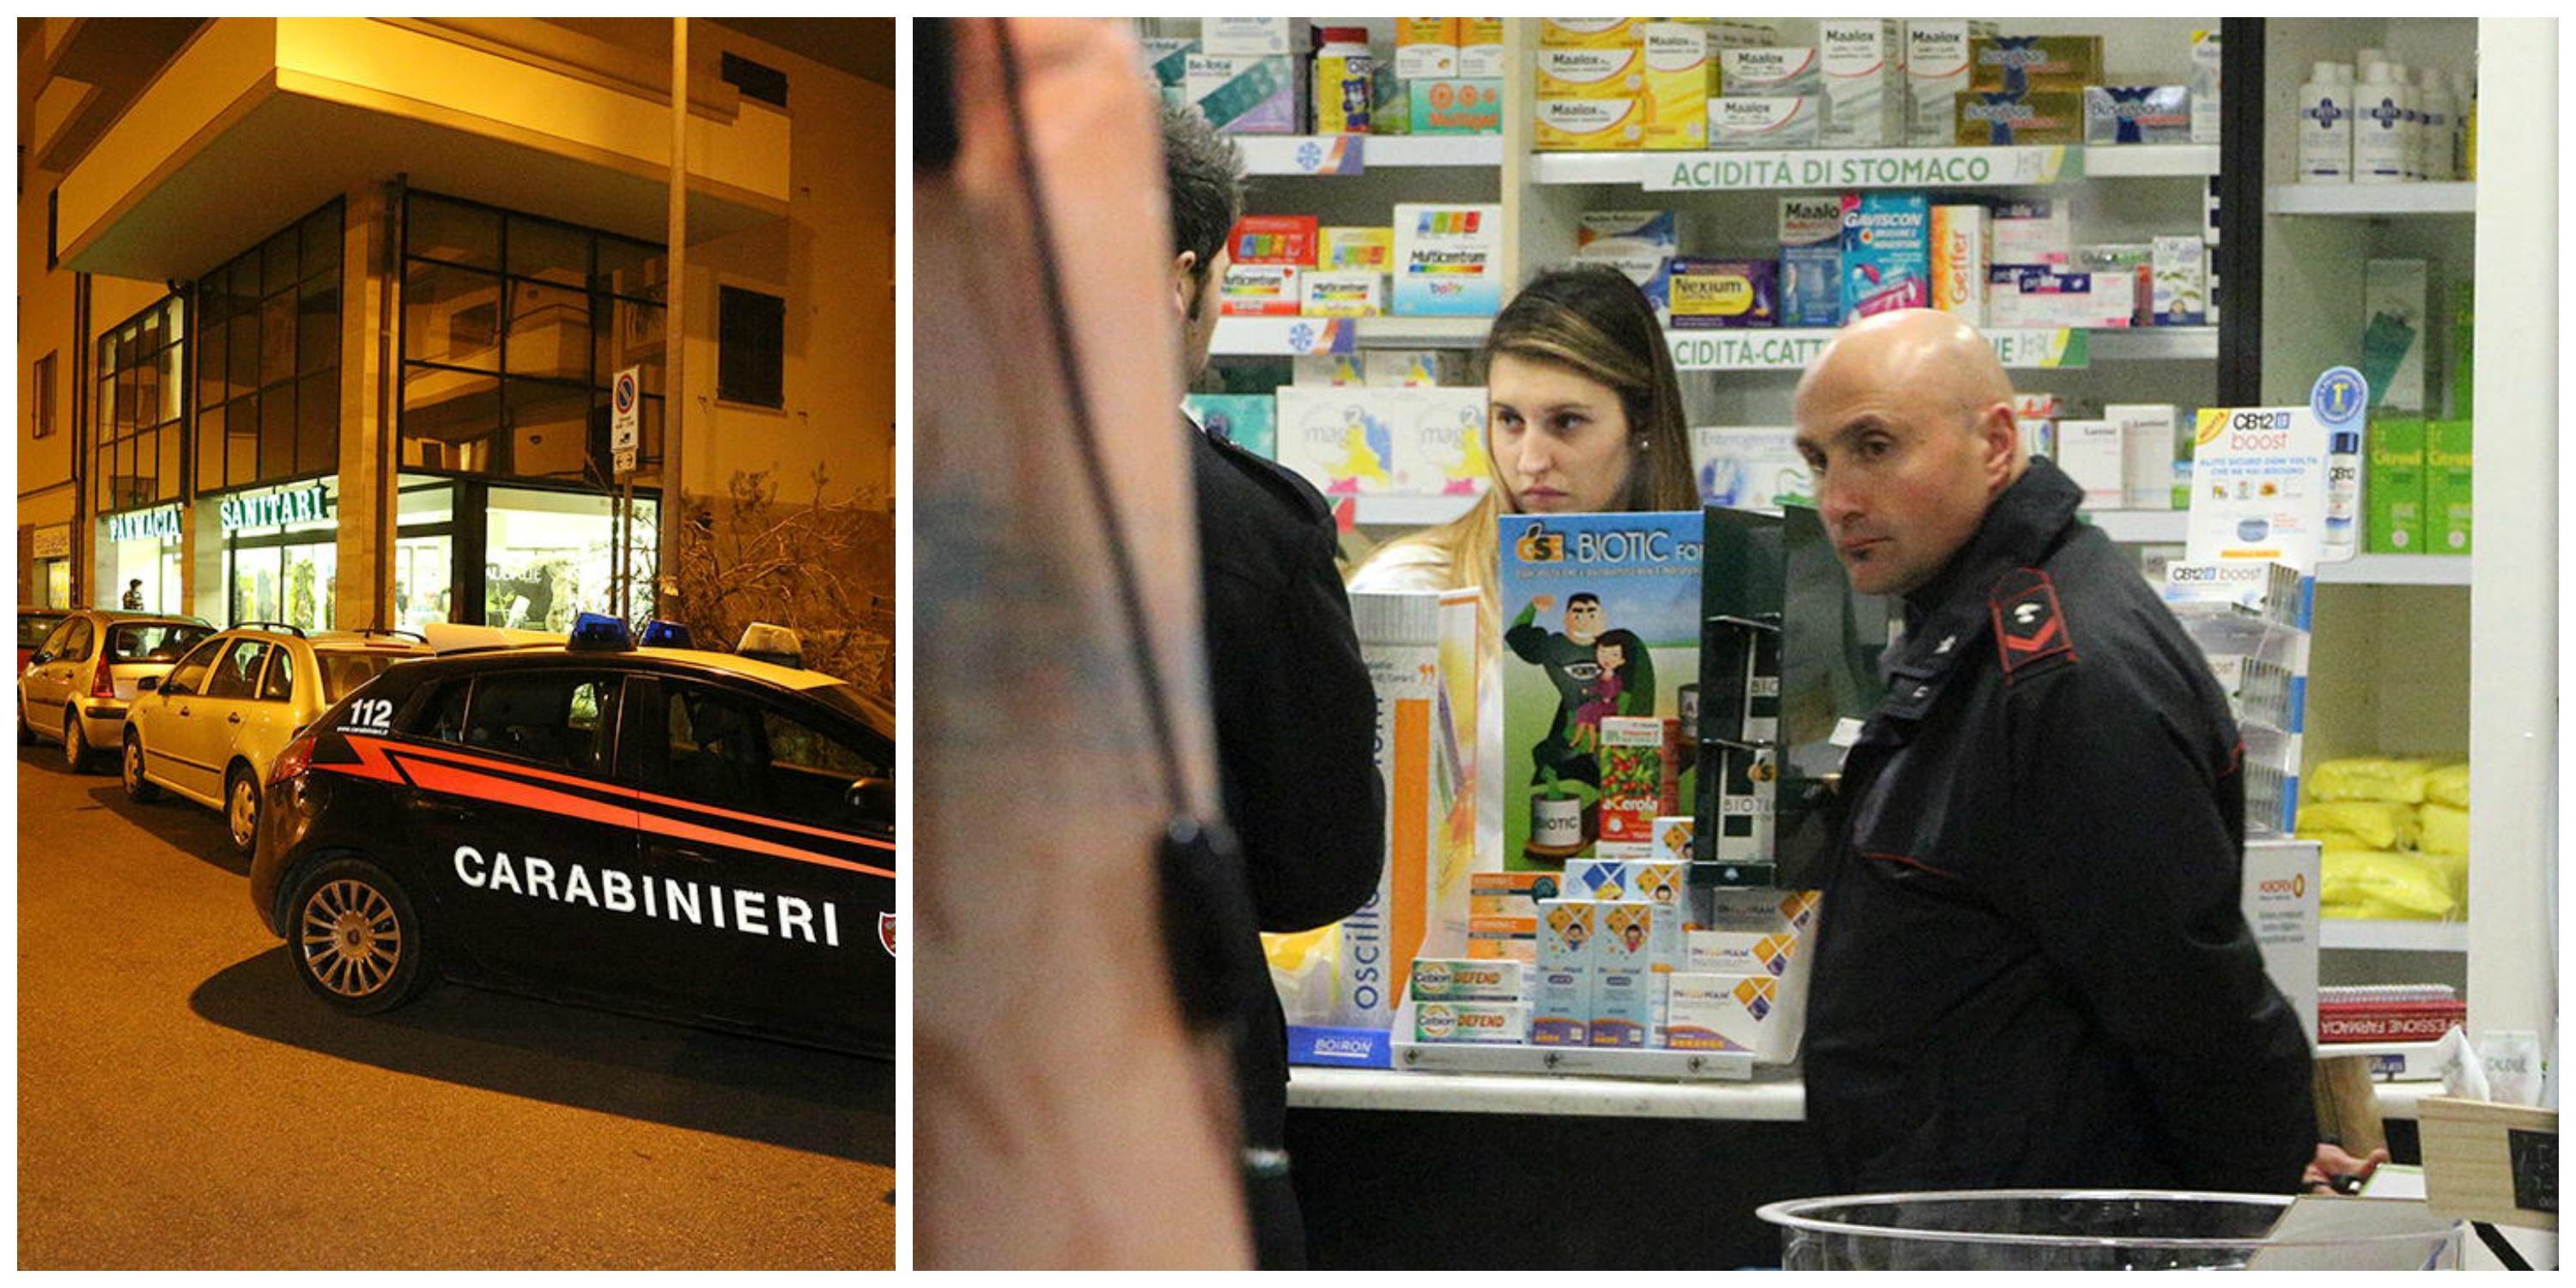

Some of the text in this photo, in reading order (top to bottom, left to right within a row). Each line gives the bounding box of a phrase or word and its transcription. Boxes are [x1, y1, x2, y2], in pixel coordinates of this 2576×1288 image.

[1649, 34, 1691, 47] Maalox
[1826, 28, 1875, 44] Maalox
[1912, 30, 1961, 44] Maalox
[1552, 53, 1598, 66] Maalox
[1737, 52, 1783, 65] Maalox
[1550, 103, 1597, 117] Maalox
[1724, 101, 1771, 114] Maalox
[1672, 155, 1990, 186] ACIDITÀ DI STOMACO
[1844, 211, 1923, 228] GAVISCON
[1411, 251, 1487, 263] Multicentrum
[1675, 279, 1742, 295] Nexium
[2233, 413, 2274, 430] CB12
[221, 485, 325, 532] SANITARI
[107, 508, 181, 543] FARMACIA
[1577, 531, 1670, 564] BIOTIC
[349, 698, 393, 728] 112
[1602, 794, 1659, 811] aCerola
[453, 845, 840, 947] CARABINIERI
[1453, 971, 1501, 984] DEFEND
[1457, 1014, 1505, 1028] DEFEND
[1313, 1039, 1373, 1054] BOIRON
